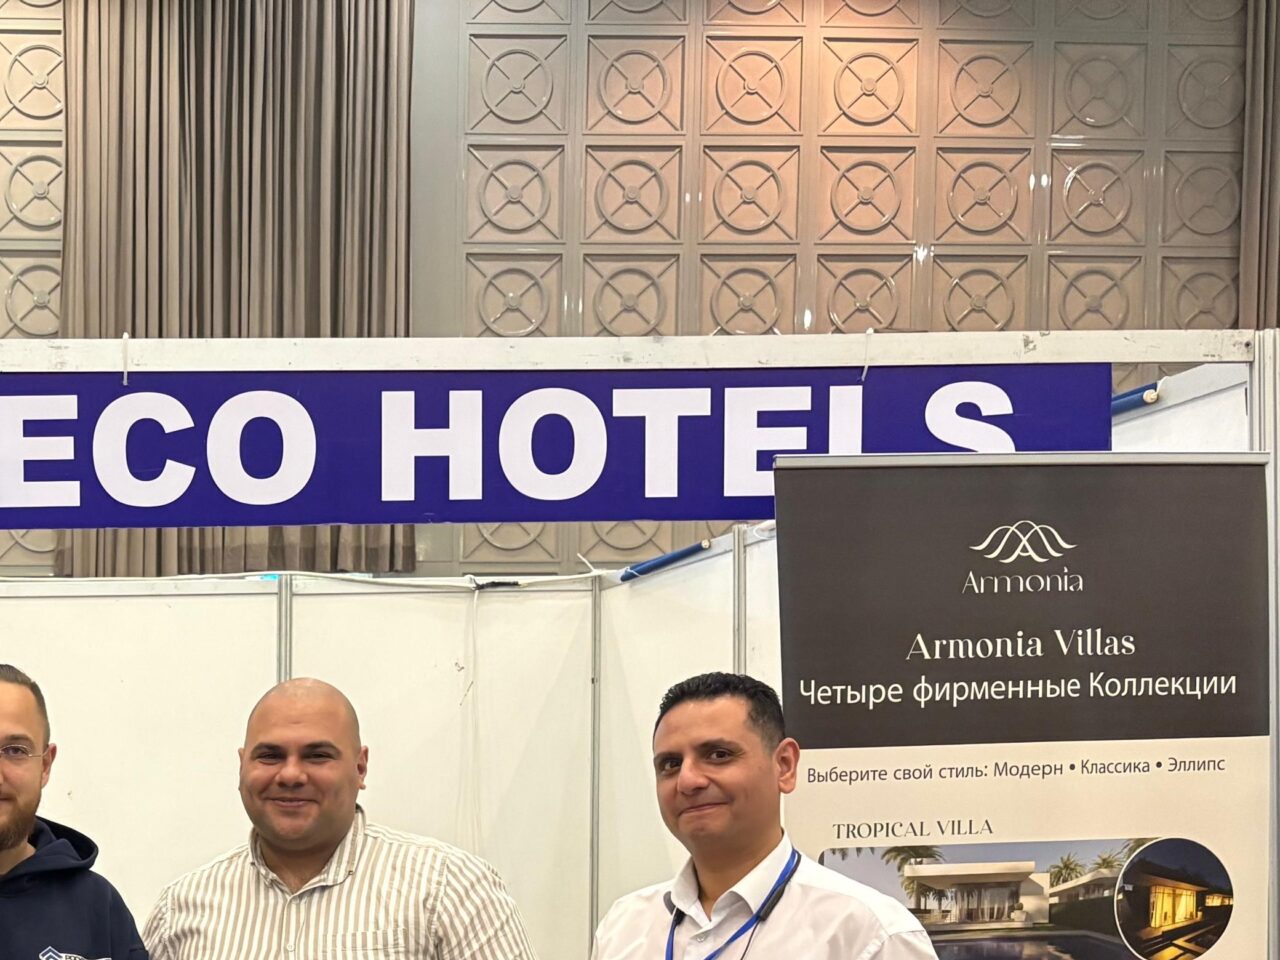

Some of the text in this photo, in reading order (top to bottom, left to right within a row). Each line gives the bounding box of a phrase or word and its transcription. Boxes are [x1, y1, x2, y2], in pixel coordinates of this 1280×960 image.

[962, 567, 1084, 594] Armonia
[906, 628, 1136, 661] Armonia Villas
[800, 672, 1237, 709] Четыре фирменные Коллекции
[807, 757, 1226, 784] Выберите свой стиль: Модерн Классика Эллипс
[832, 819, 994, 840] TROPICAL VILLA
